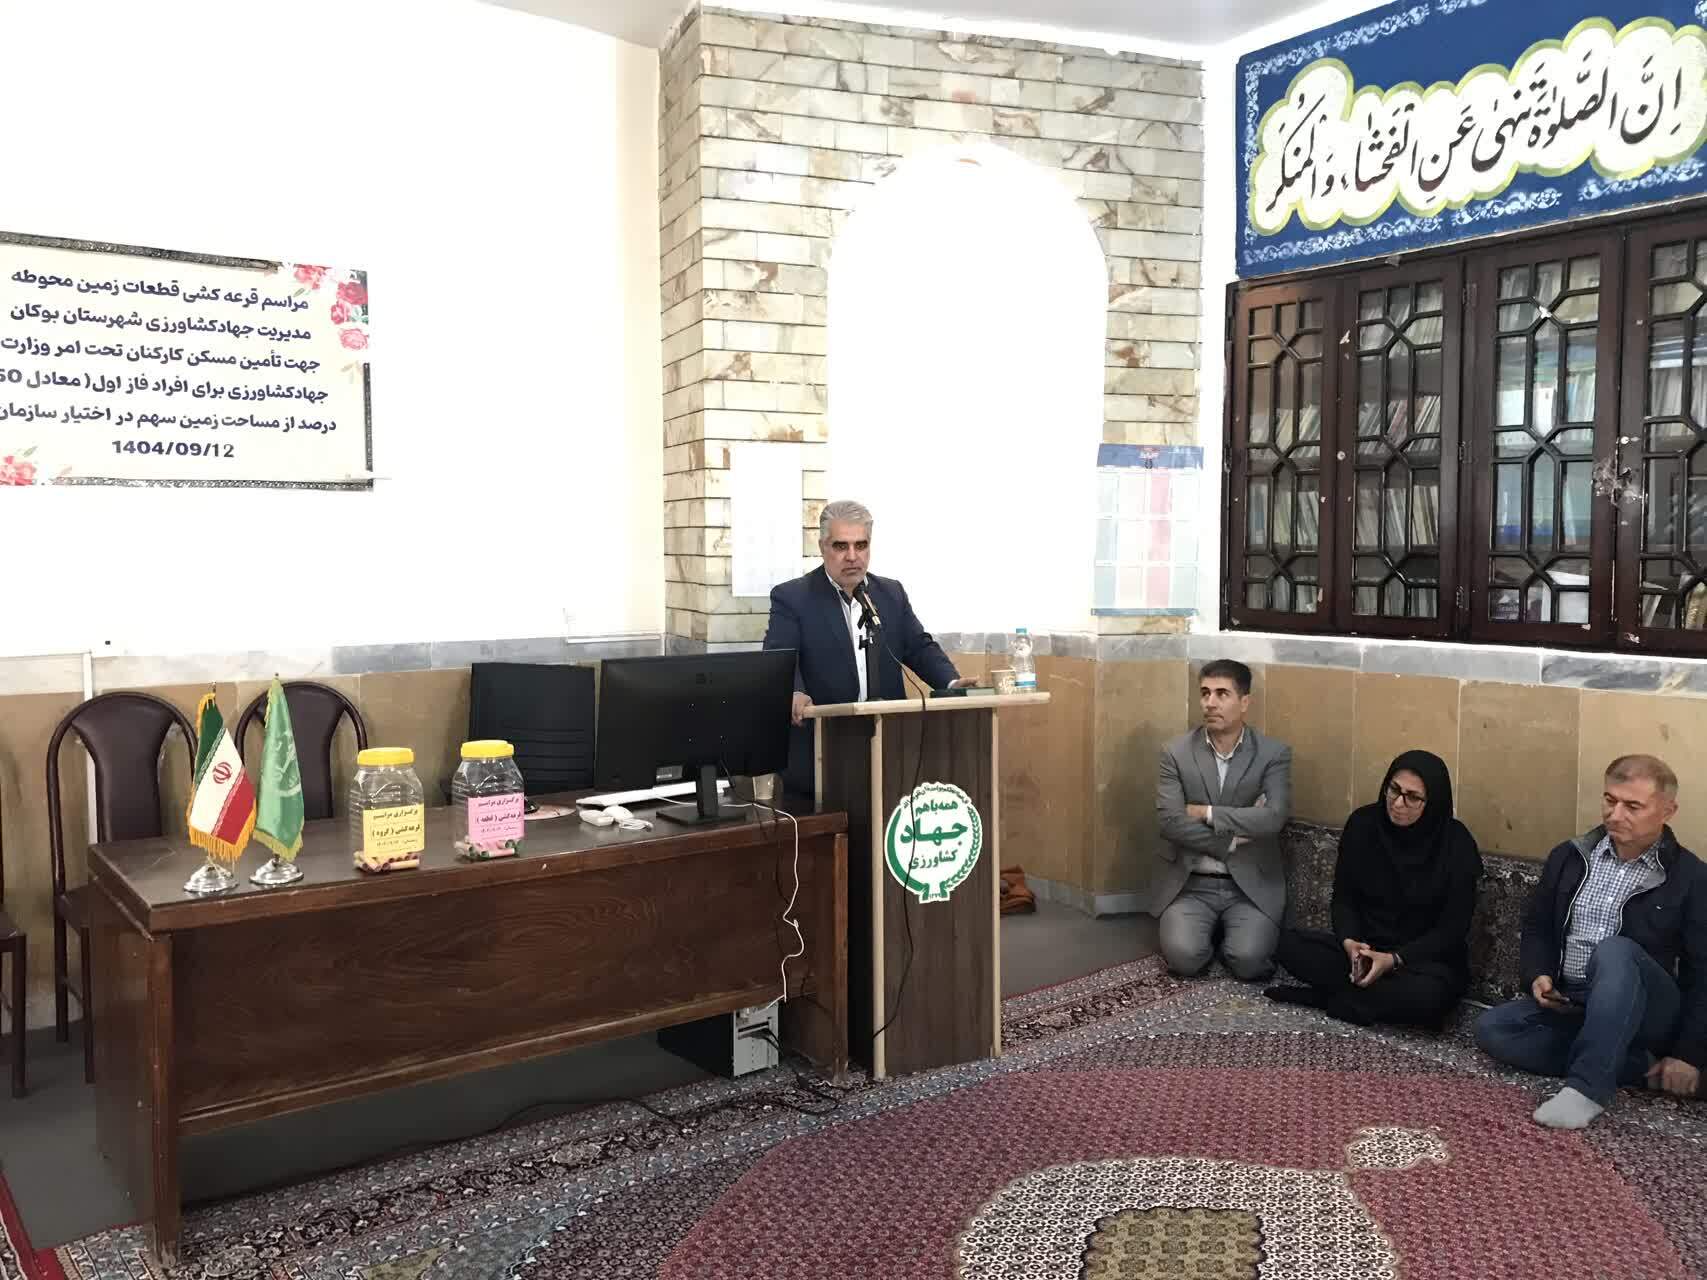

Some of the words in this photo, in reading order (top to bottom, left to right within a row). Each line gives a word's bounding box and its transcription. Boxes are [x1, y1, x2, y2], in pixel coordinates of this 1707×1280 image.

[11, 269, 74, 289] محوطه
[77, 279, 120, 296] زمین
[123, 280, 180, 296] قطعات
[183, 286, 221, 303] کشی
[223, 288, 259, 308] قرعه
[261, 296, 309, 312] مراسم
[10, 303, 60, 323] بوکان
[63, 307, 143, 329] شهرستان
[257, 326, 312, 342] مدیریت
[0, 336, 51, 356] وزارت
[54, 340, 81, 357] امر
[84, 344, 123, 357] تحت
[126, 345, 184, 364] کارکنان
[187, 350, 237, 366] مسکن
[239, 350, 281, 370] تأمین
[284, 359, 321, 373] جهت
[125, 373, 149, 394] فاز
[152, 375, 188, 396] افراد
[192, 381, 225, 399] برای
[61, 405, 111, 423] اختیار
[115, 411, 134, 425] در
[137, 412, 176, 428] سهم
[179, 414, 219, 429] زمین
[221, 414, 280, 428] مساحت
[282, 416, 295, 432] از
[298, 418, 337, 434] درصد
[112, 440, 235, 458] 1404/09/12
[900, 818, 968, 847] جهاد
[910, 848, 958, 869] کشاورزی
